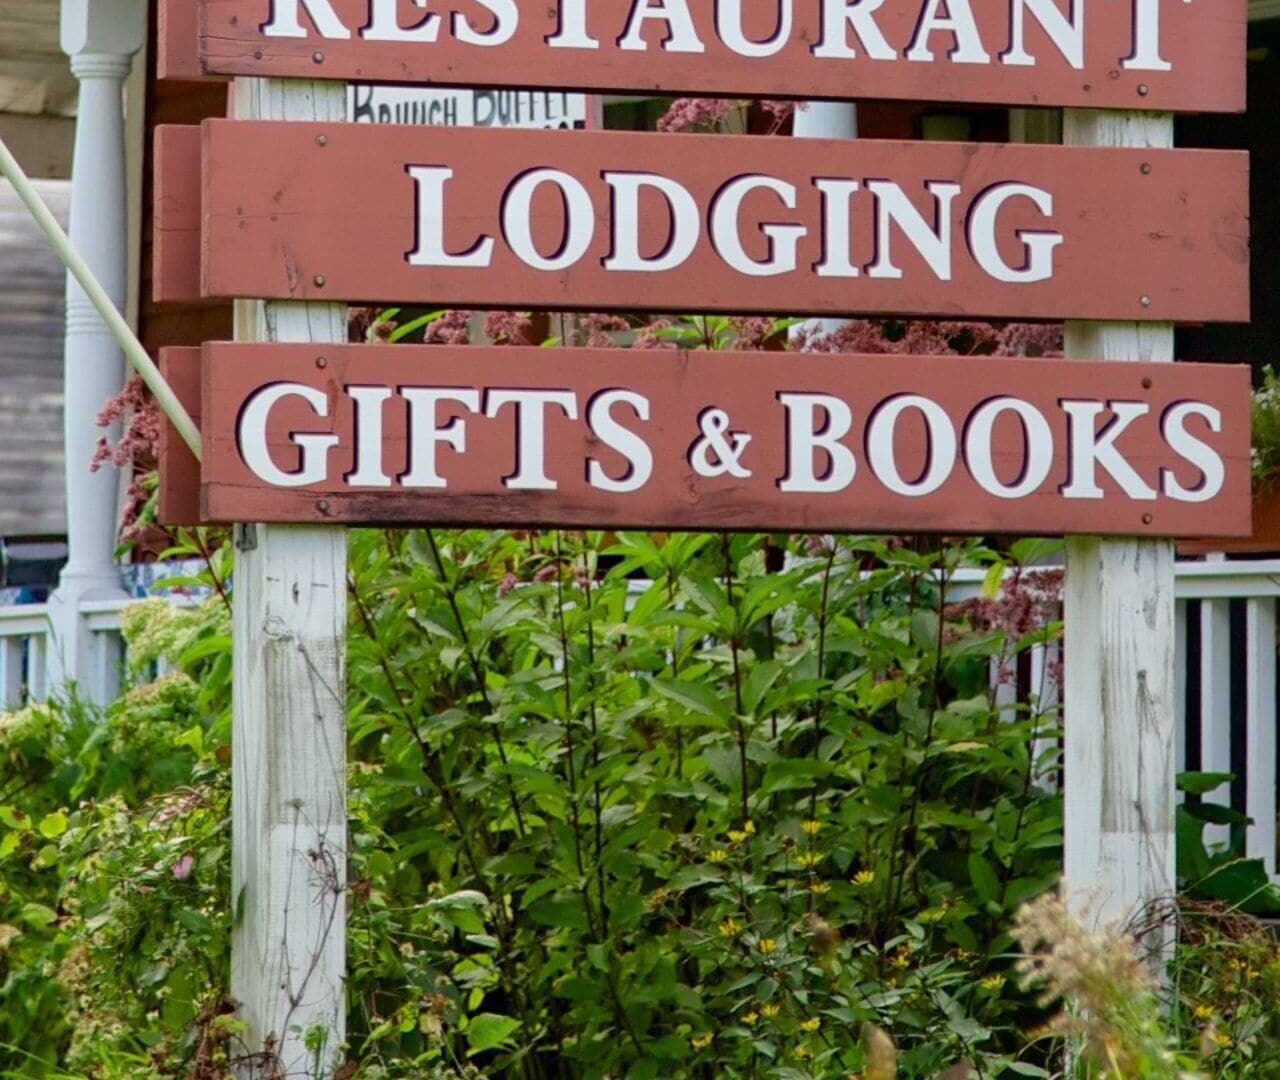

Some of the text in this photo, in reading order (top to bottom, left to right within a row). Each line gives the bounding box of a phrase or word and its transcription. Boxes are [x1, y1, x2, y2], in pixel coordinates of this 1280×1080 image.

[409, 166, 1064, 283] LODGING
[239, 382, 1226, 503] GIFTS & BOOKS
